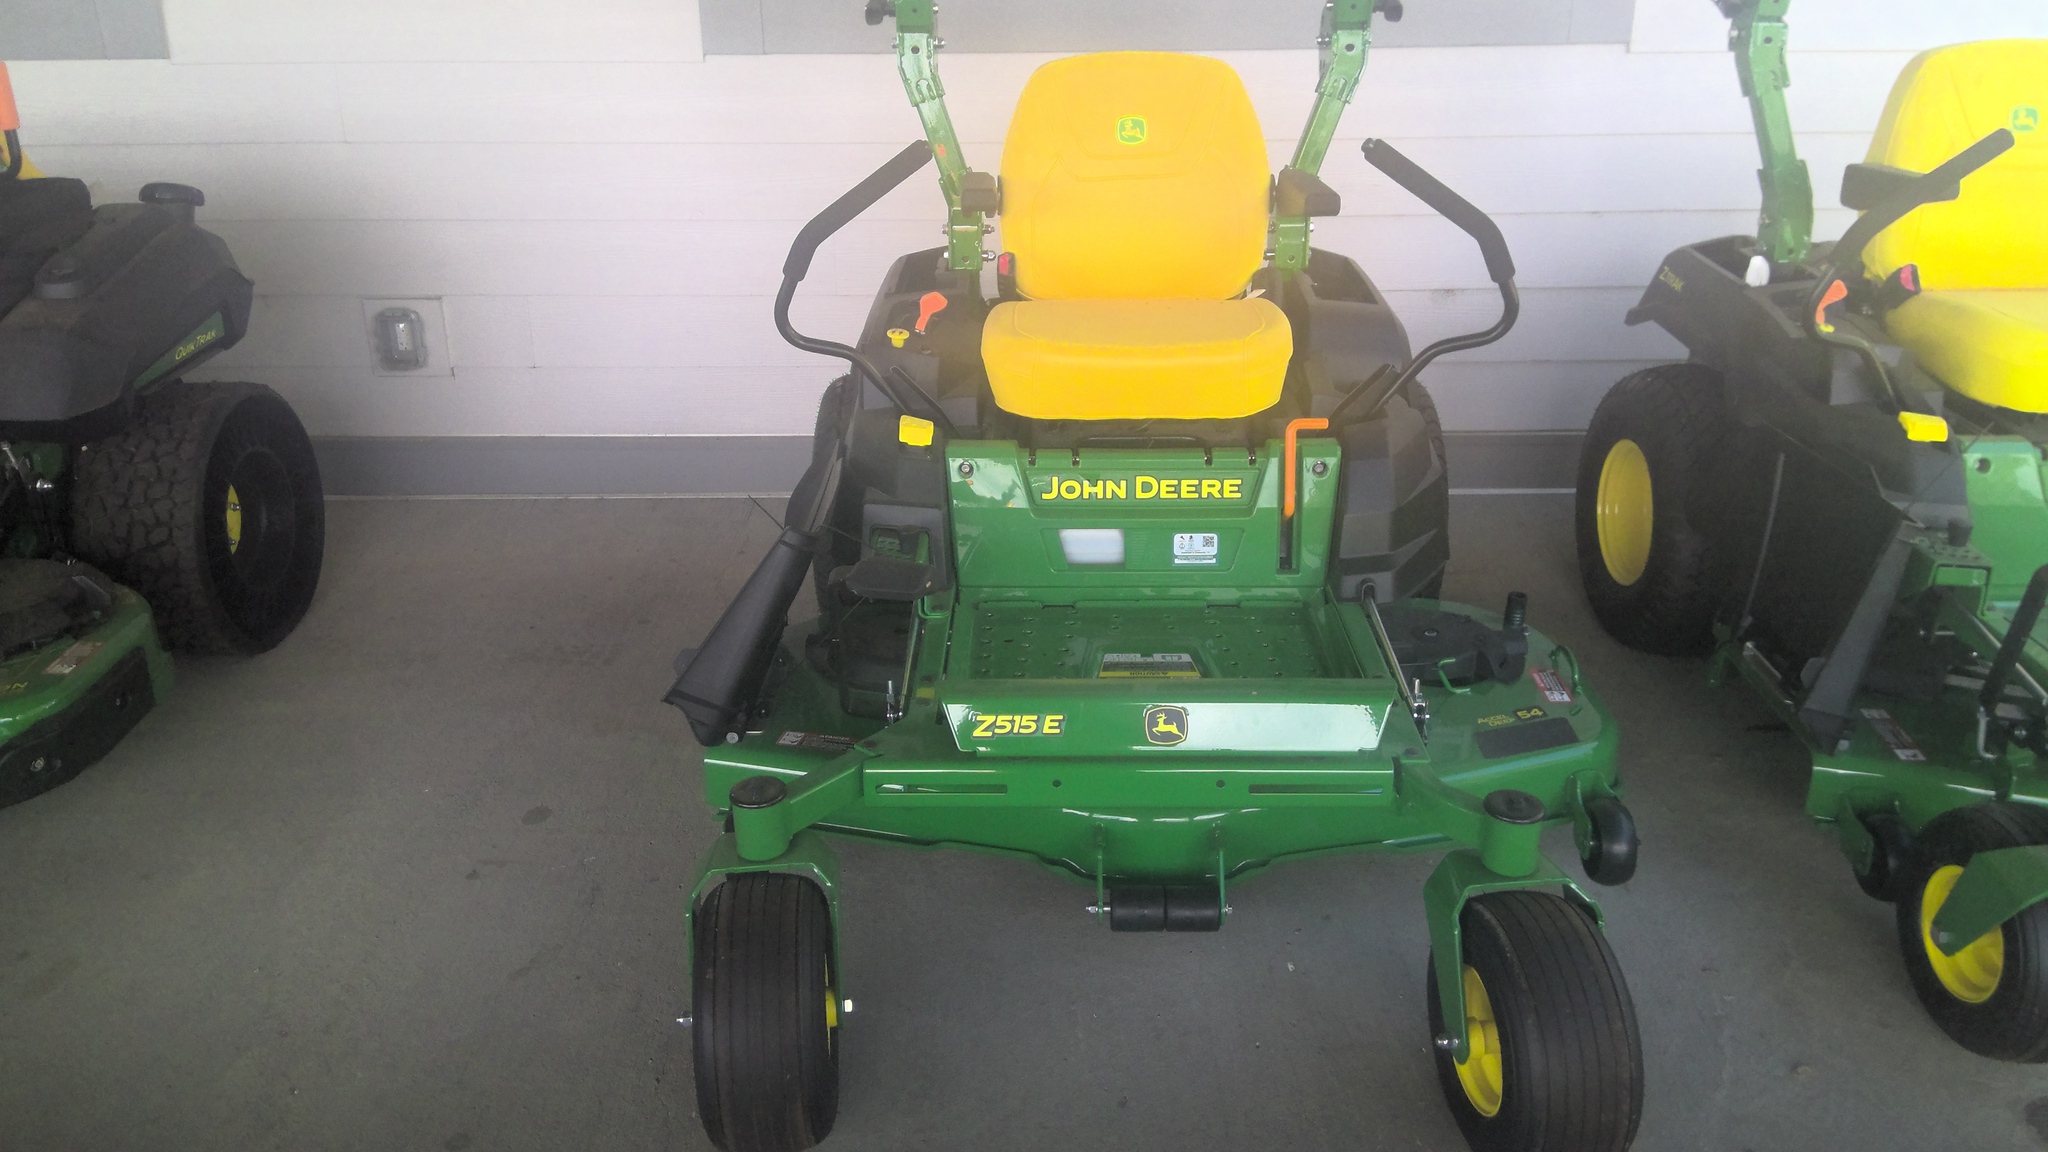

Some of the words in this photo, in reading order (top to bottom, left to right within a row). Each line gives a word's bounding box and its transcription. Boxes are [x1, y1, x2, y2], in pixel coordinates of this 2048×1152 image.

[1041, 475, 1128, 500] JOHN
[1134, 475, 1243, 499] DEERE
[1517, 708, 1544, 719] 54
[972, 714, 1039, 738] Z515
[1042, 714, 1064, 735] E
